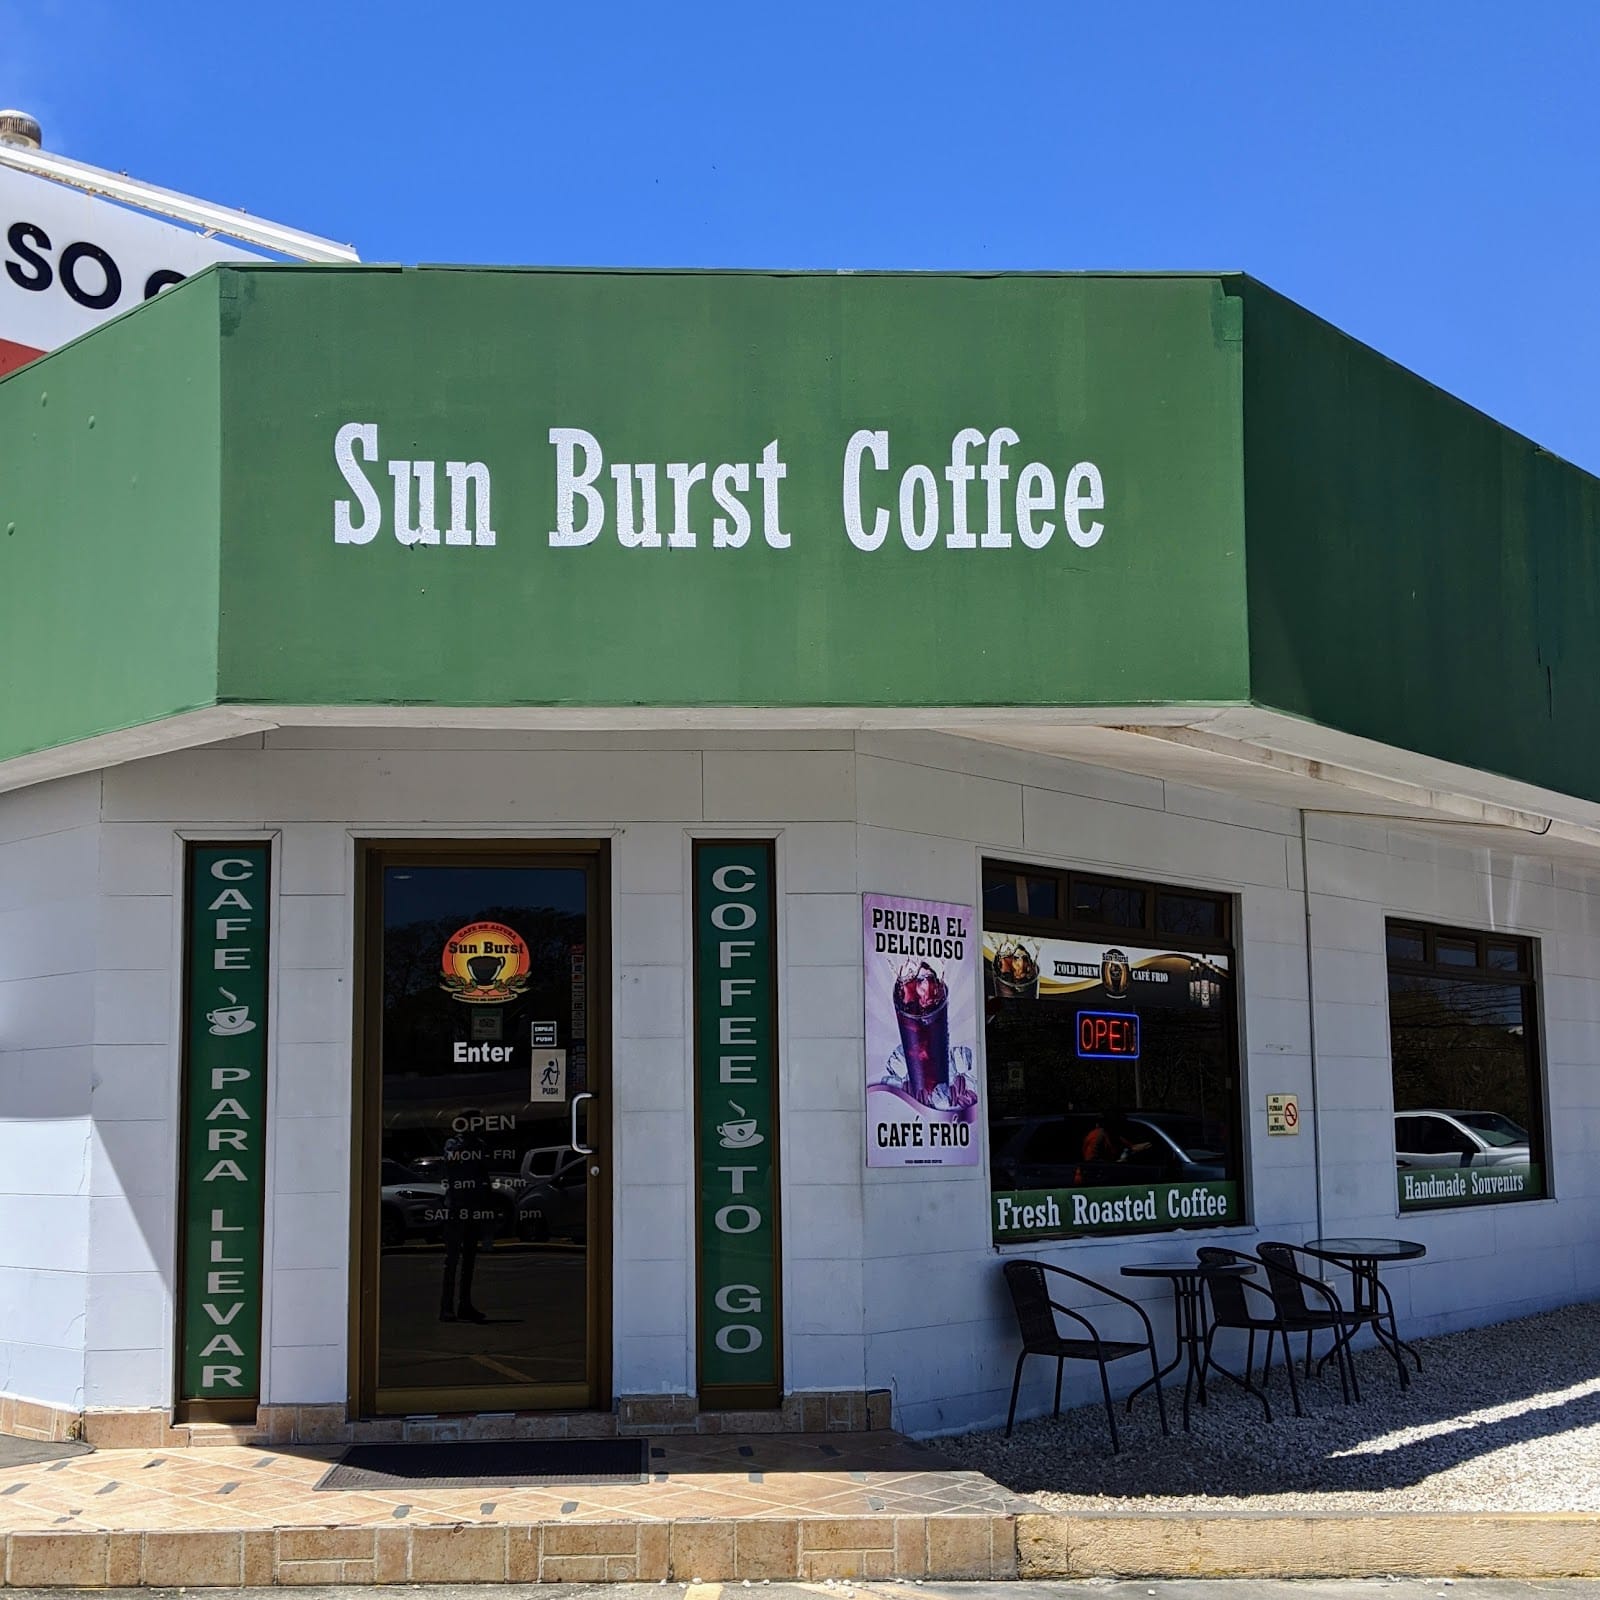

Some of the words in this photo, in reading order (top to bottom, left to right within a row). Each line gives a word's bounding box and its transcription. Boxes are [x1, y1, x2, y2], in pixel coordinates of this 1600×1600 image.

[5, 222, 122, 310] SO
[334, 421, 497, 547] Sun
[548, 427, 792, 550] Burst
[842, 426, 1106, 552] Coffee
[207, 858, 254, 970] CAFE
[872, 907, 941, 937] PRUEBA
[946, 917, 967, 938] EL
[449, 941, 478, 954] Sun
[484, 941, 524, 954] Burst
[875, 932, 964, 961] DELICIOSO
[710, 864, 758, 1084] COFFEE
[1056, 963, 1077, 975] COLD
[1077, 964, 1100, 977] BREW
[1131, 969, 1151, 982] CAFÉ
[1151, 971, 1169, 983] FRIO
[1081, 1018, 1136, 1052] OPEN
[453, 1042, 514, 1063] Enter
[542, 1087, 559, 1095] PUSH
[202, 1067, 252, 1182] PARA
[452, 1114, 516, 1133] OPEN
[877, 1115, 923, 1148] CAFÉ
[929, 1115, 970, 1147] FRÍO
[447, 1150, 481, 1161] MON
[493, 1149, 516, 1160] FRI
[453, 1179, 476, 1190] am
[503, 1178, 527, 1191] pm
[1404, 1172, 1467, 1200] Handmade
[1471, 1169, 1524, 1195] Souvenirs
[459, 1208, 469, 1220] 8
[472, 1210, 495, 1220] am
[519, 1208, 543, 1222] pm
[713, 1166, 762, 1235] TO
[997, 1196, 1061, 1231] Fresh
[1072, 1190, 1157, 1226] Roasted
[1167, 1187, 1228, 1219] Coffee
[198, 1208, 246, 1388] LLEVAR
[713, 1283, 763, 1355] GO
